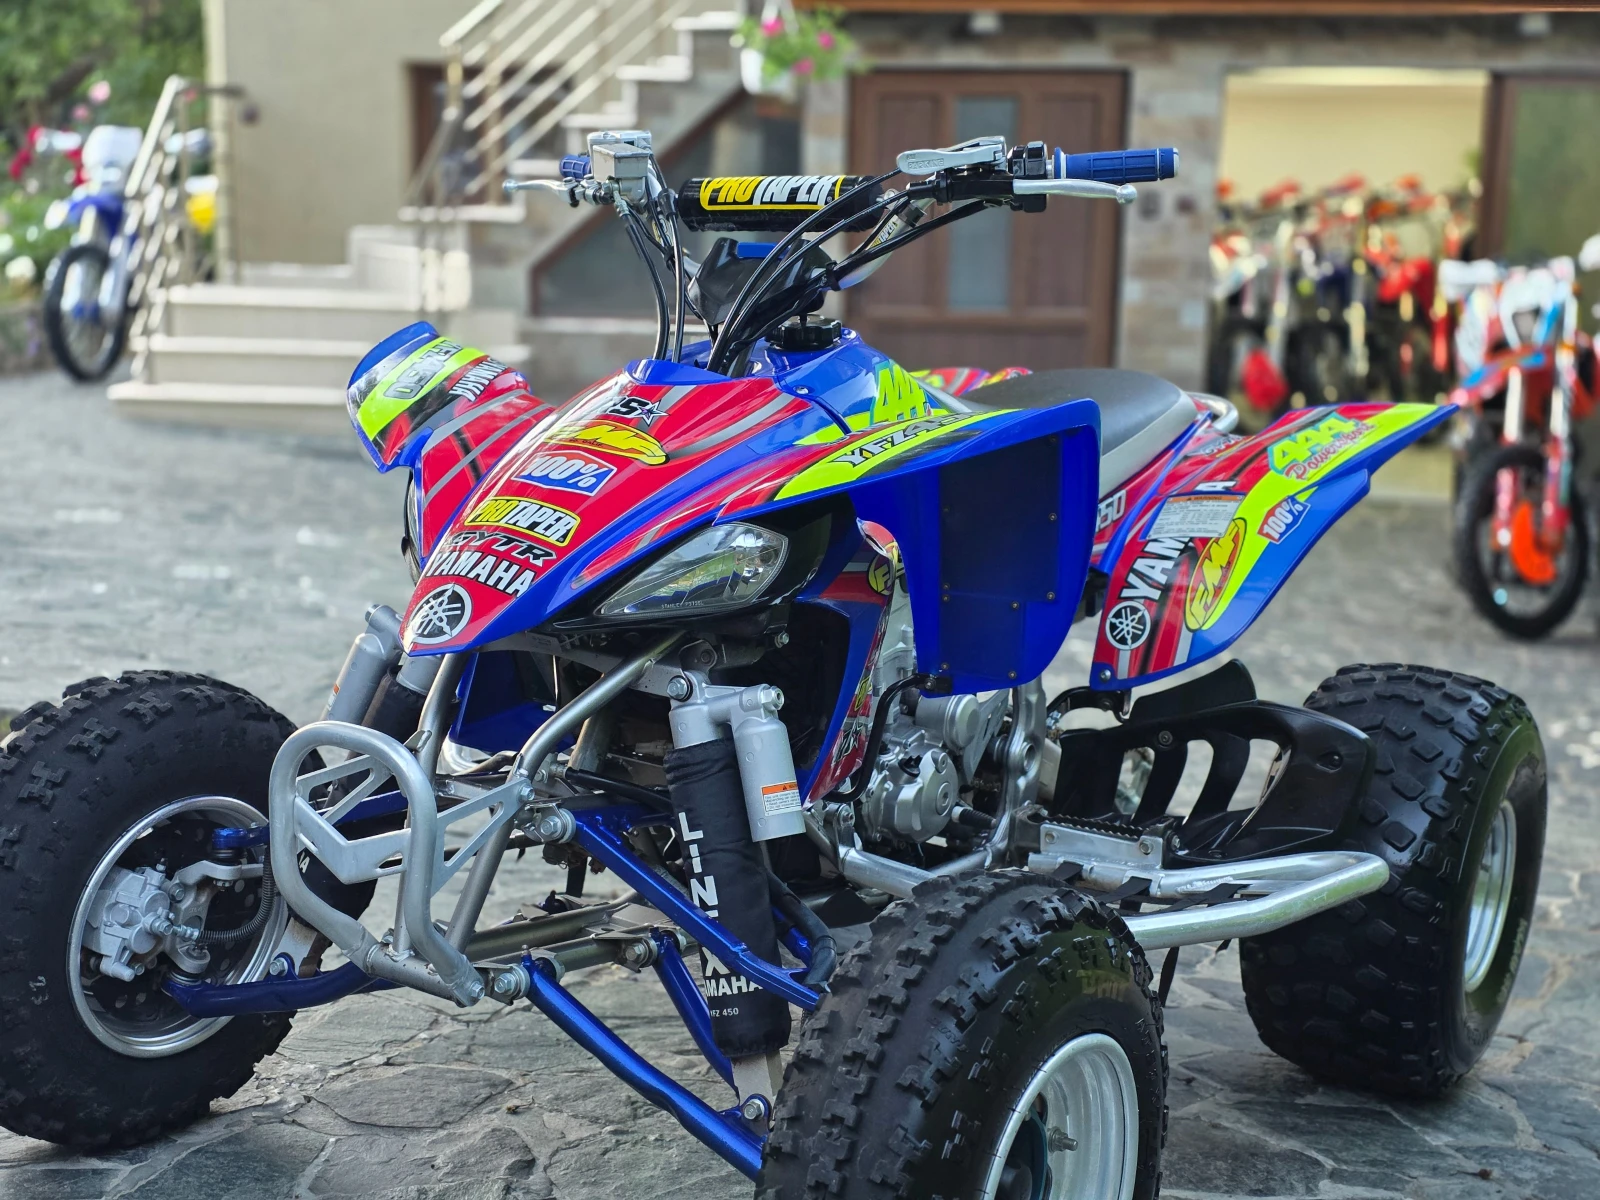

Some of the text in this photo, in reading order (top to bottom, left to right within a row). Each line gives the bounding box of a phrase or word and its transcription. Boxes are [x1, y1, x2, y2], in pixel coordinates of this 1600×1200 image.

[702, 175, 841, 206] PROTAPER
[526, 455, 600, 488] 100%
[473, 500, 578, 542] PROTAPER
[1262, 498, 1304, 540] 100%
[448, 531, 557, 567] GYTR
[425, 551, 536, 598] YAMAHA
[1190, 518, 1240, 627] FMF
[722, 1007, 739, 1017] 450
